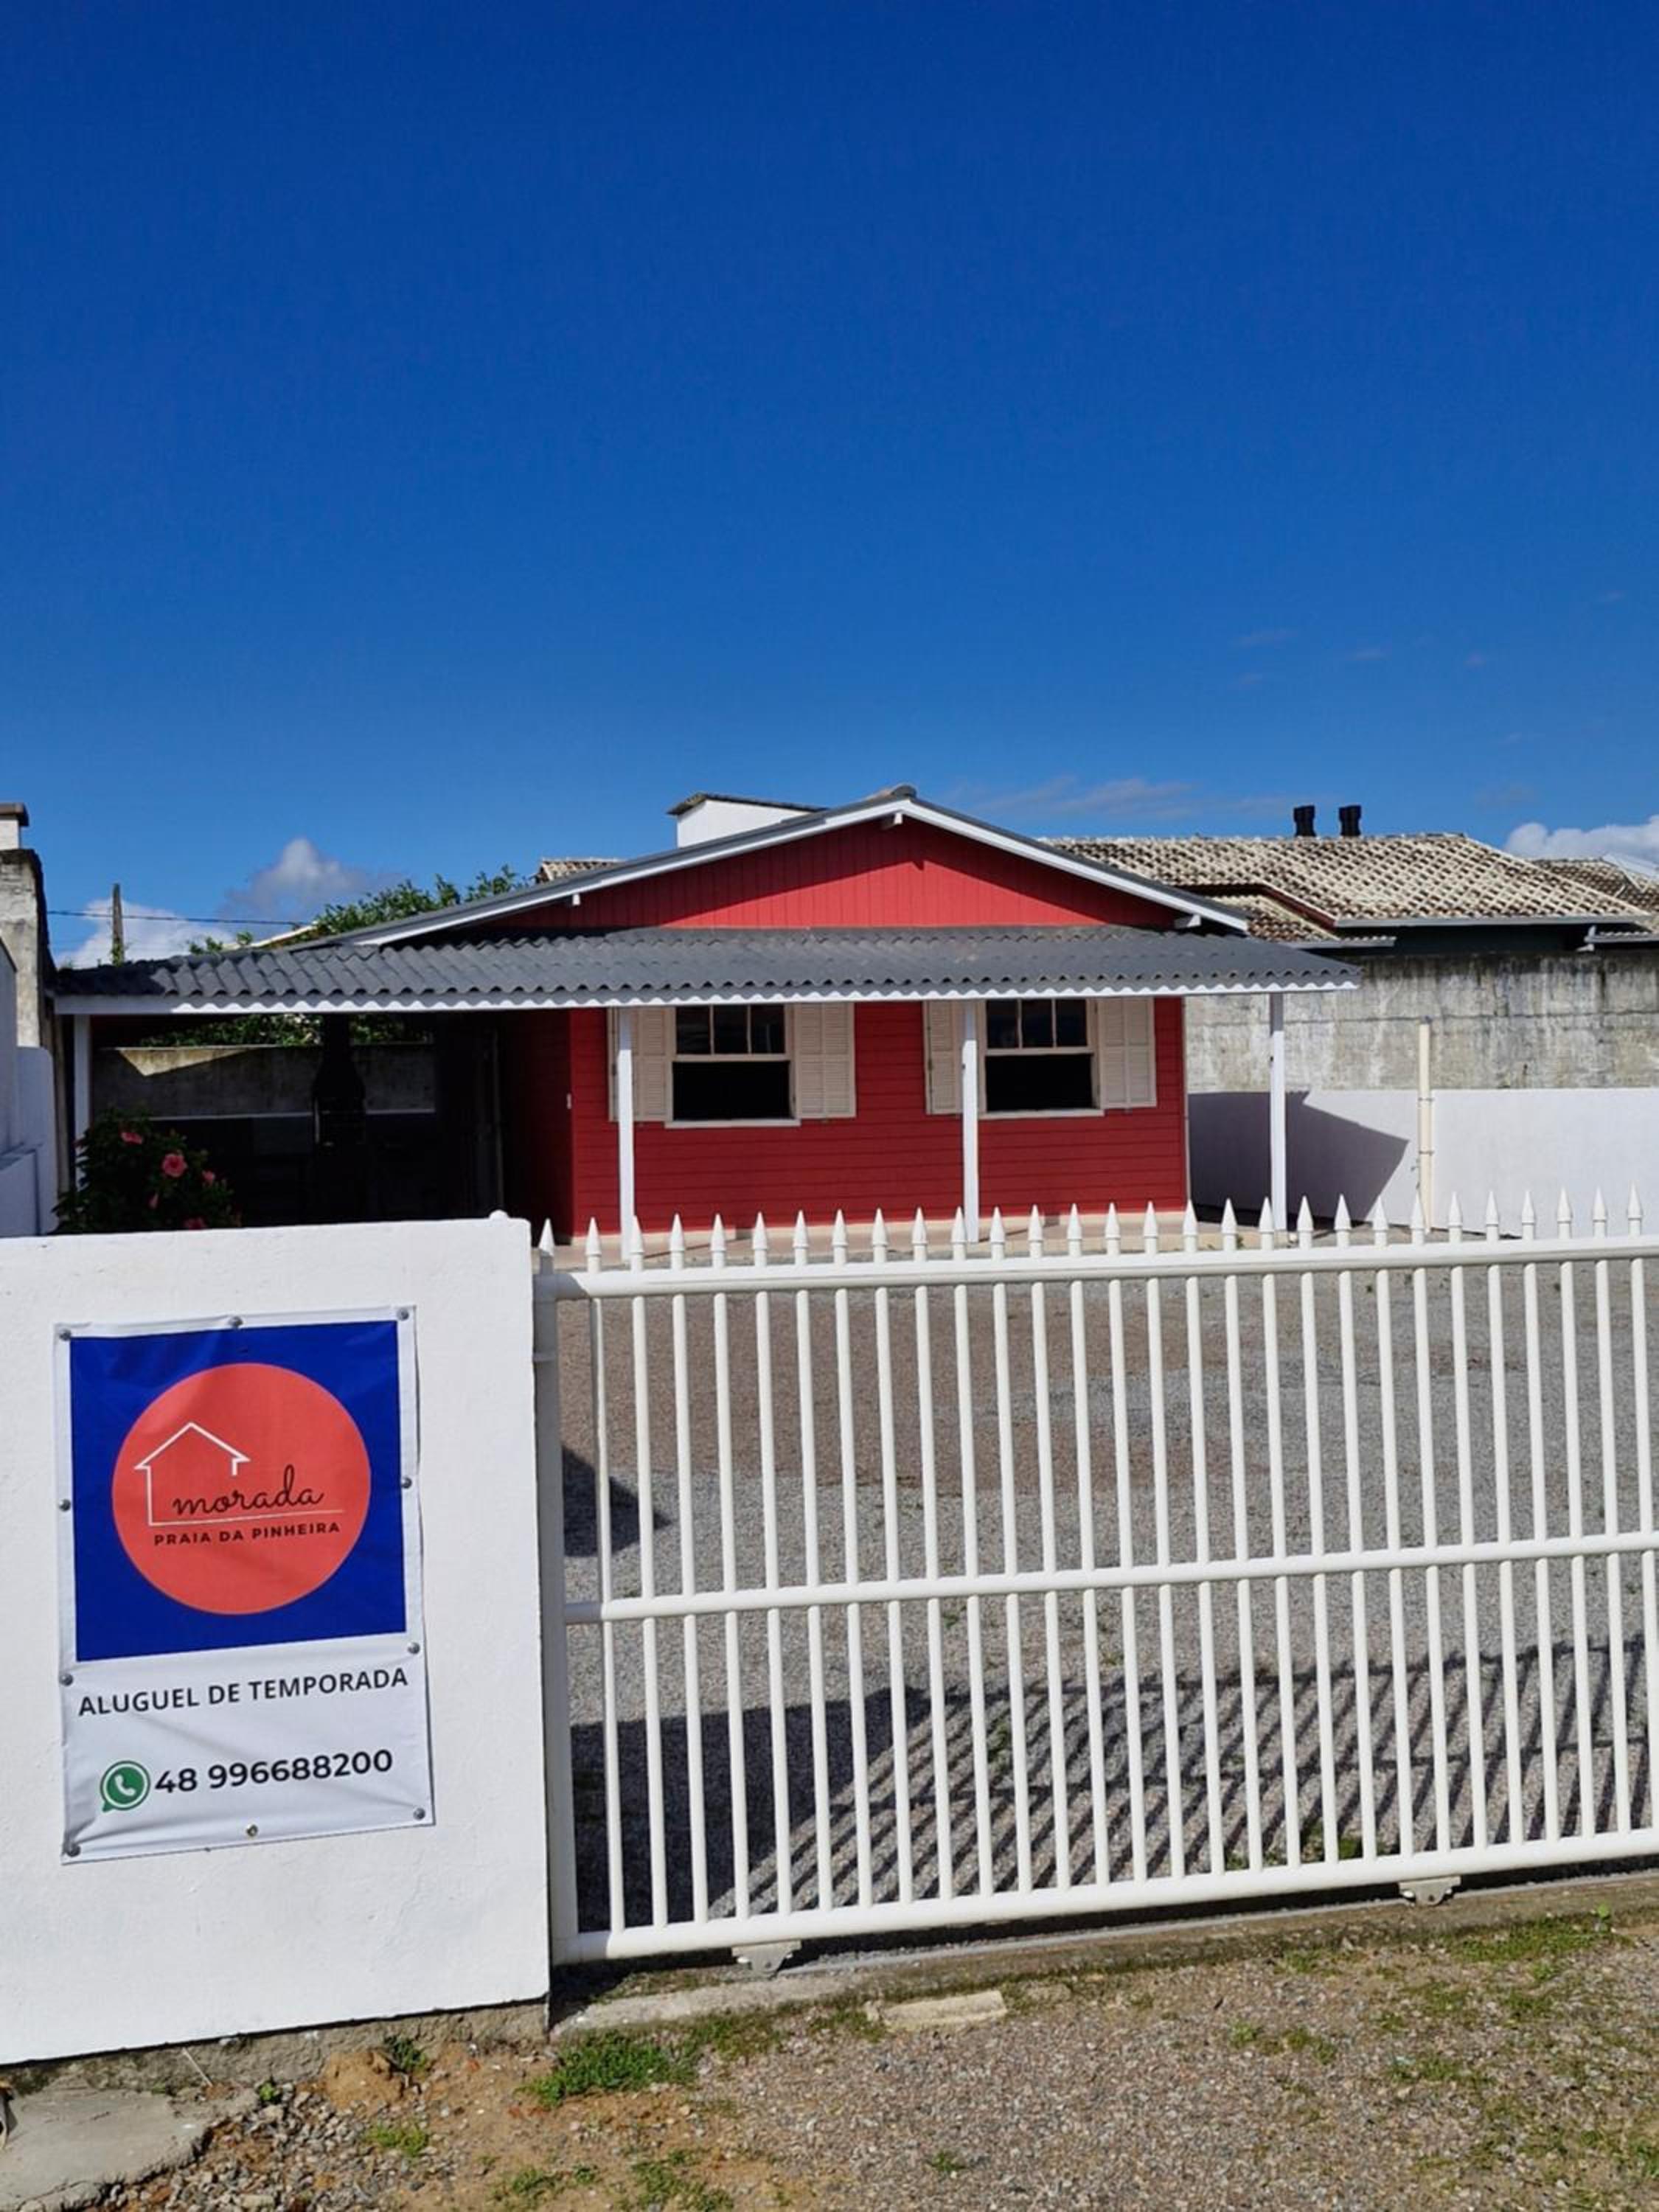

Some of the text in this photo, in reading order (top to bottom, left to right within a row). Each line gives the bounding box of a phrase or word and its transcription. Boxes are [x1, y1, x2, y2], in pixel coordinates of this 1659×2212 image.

[172, 1464, 324, 1515] morada
[153, 1522, 341, 1546] PRAIA DA PINHEIRA
[78, 1667, 408, 1717] ALUGUEL DE TEMPORADA
[154, 1748, 393, 1794] 48 996688200
